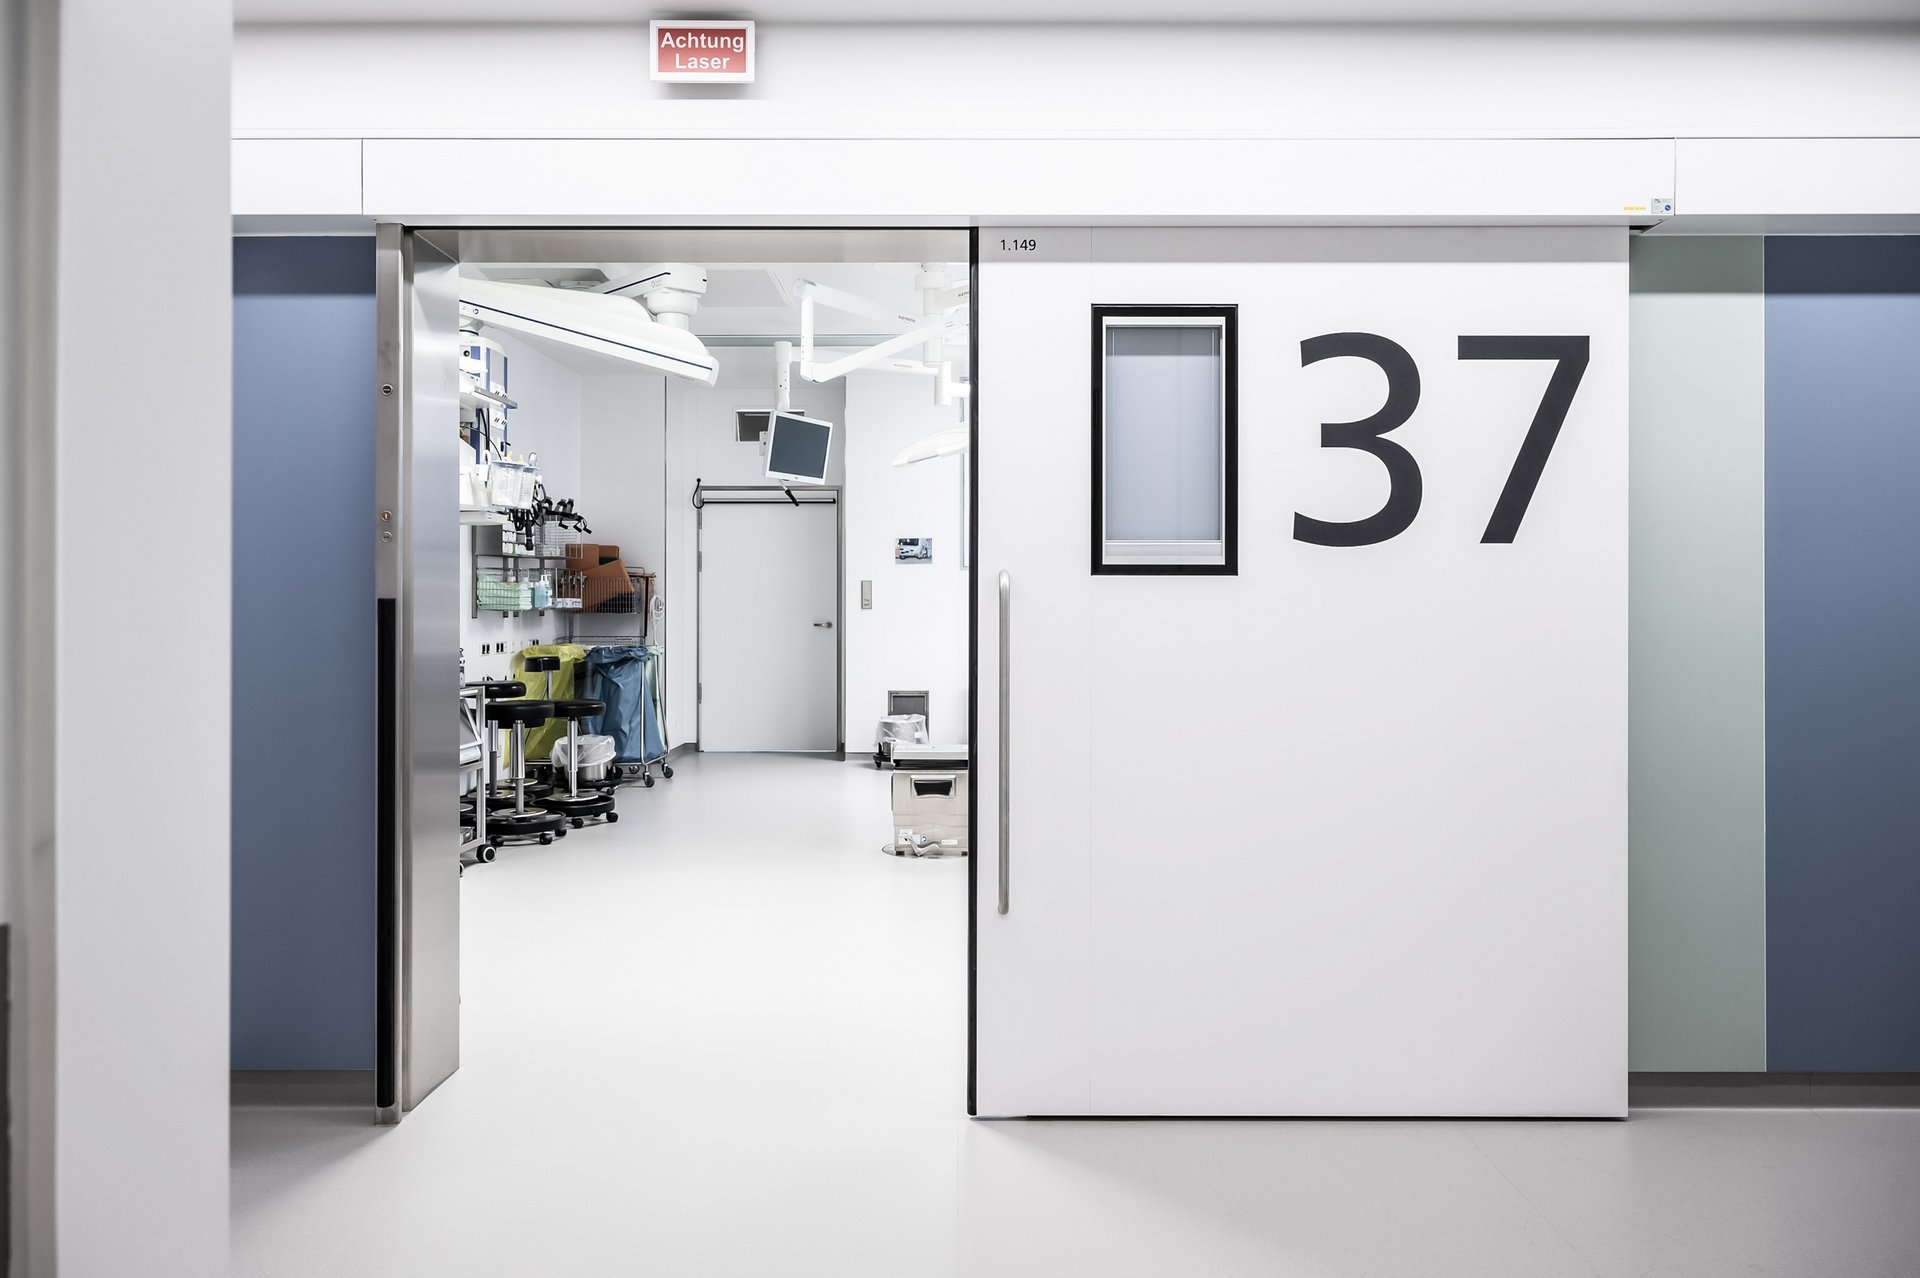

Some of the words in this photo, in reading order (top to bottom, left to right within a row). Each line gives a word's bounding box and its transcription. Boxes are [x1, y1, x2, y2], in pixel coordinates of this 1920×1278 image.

[660, 32, 744, 53] Achtung
[675, 53, 730, 69] Laser
[1000, 239, 1037, 251] 1.149
[1293, 331, 1590, 547] 37
